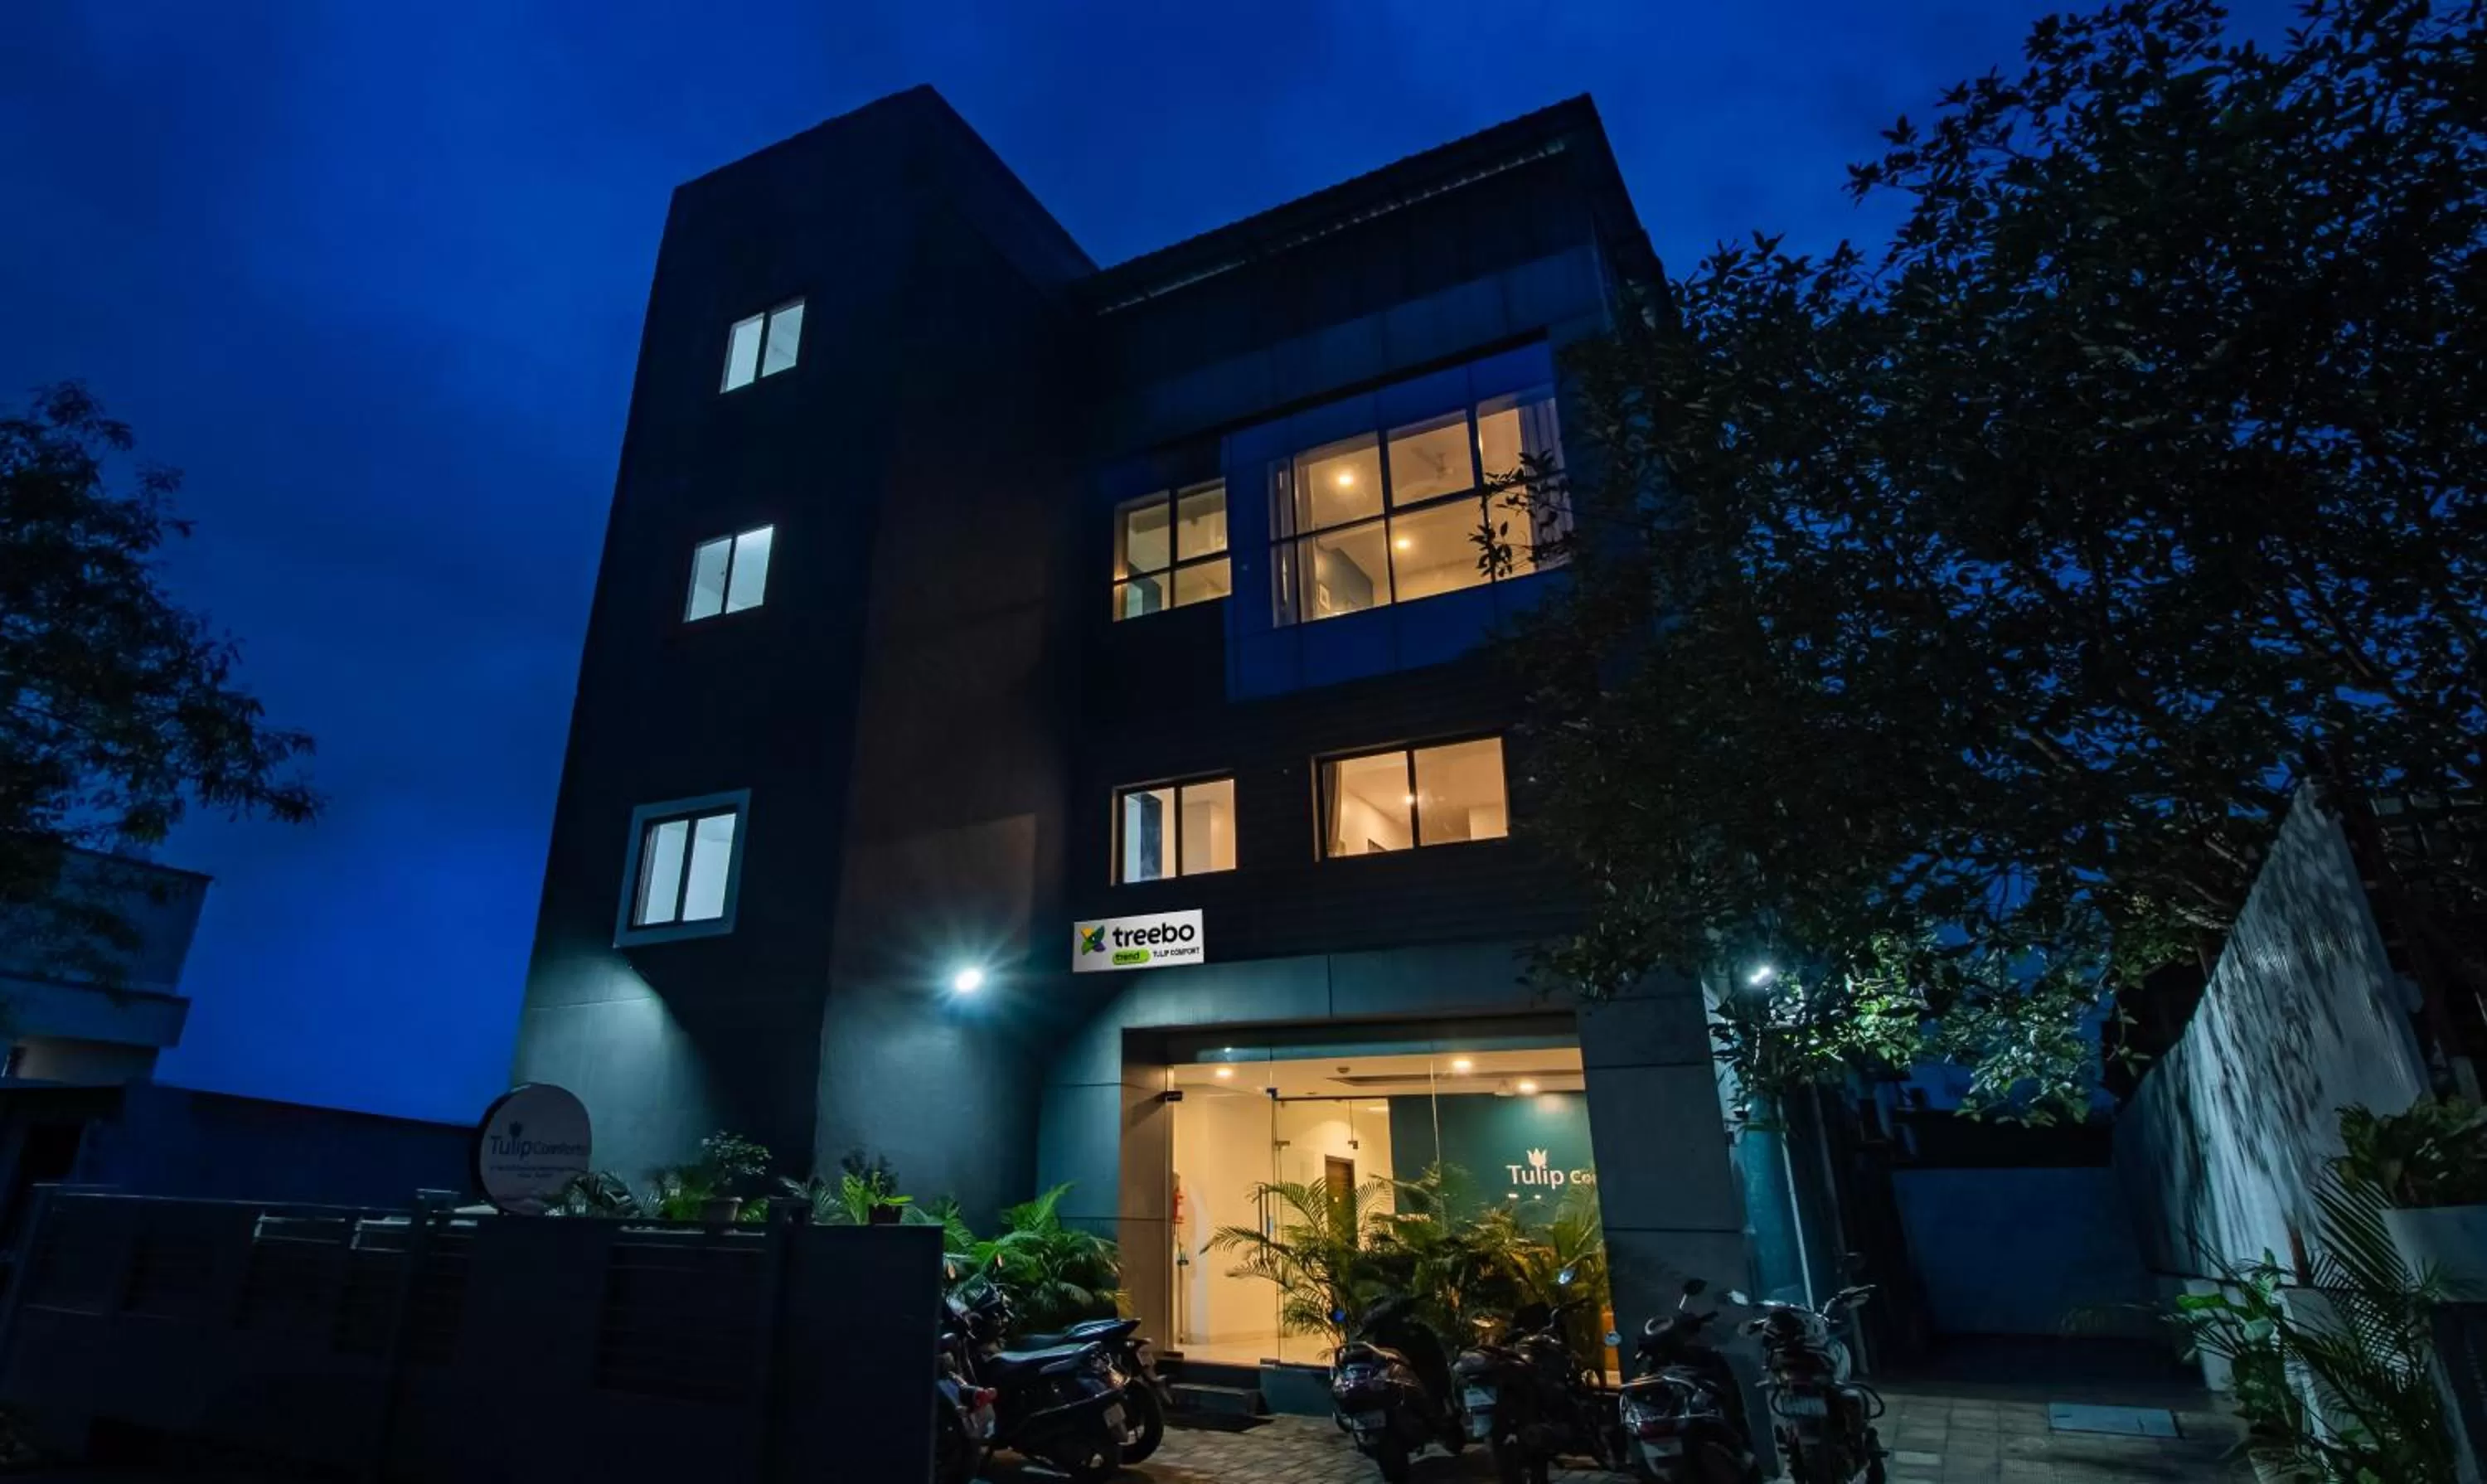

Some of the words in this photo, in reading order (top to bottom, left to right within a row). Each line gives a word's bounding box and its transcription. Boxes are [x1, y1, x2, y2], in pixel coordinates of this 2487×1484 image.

[1113, 923, 1195, 947] treebo
[491, 1136, 531, 1161] Tulip
[1505, 1163, 1564, 1190] Tulip
